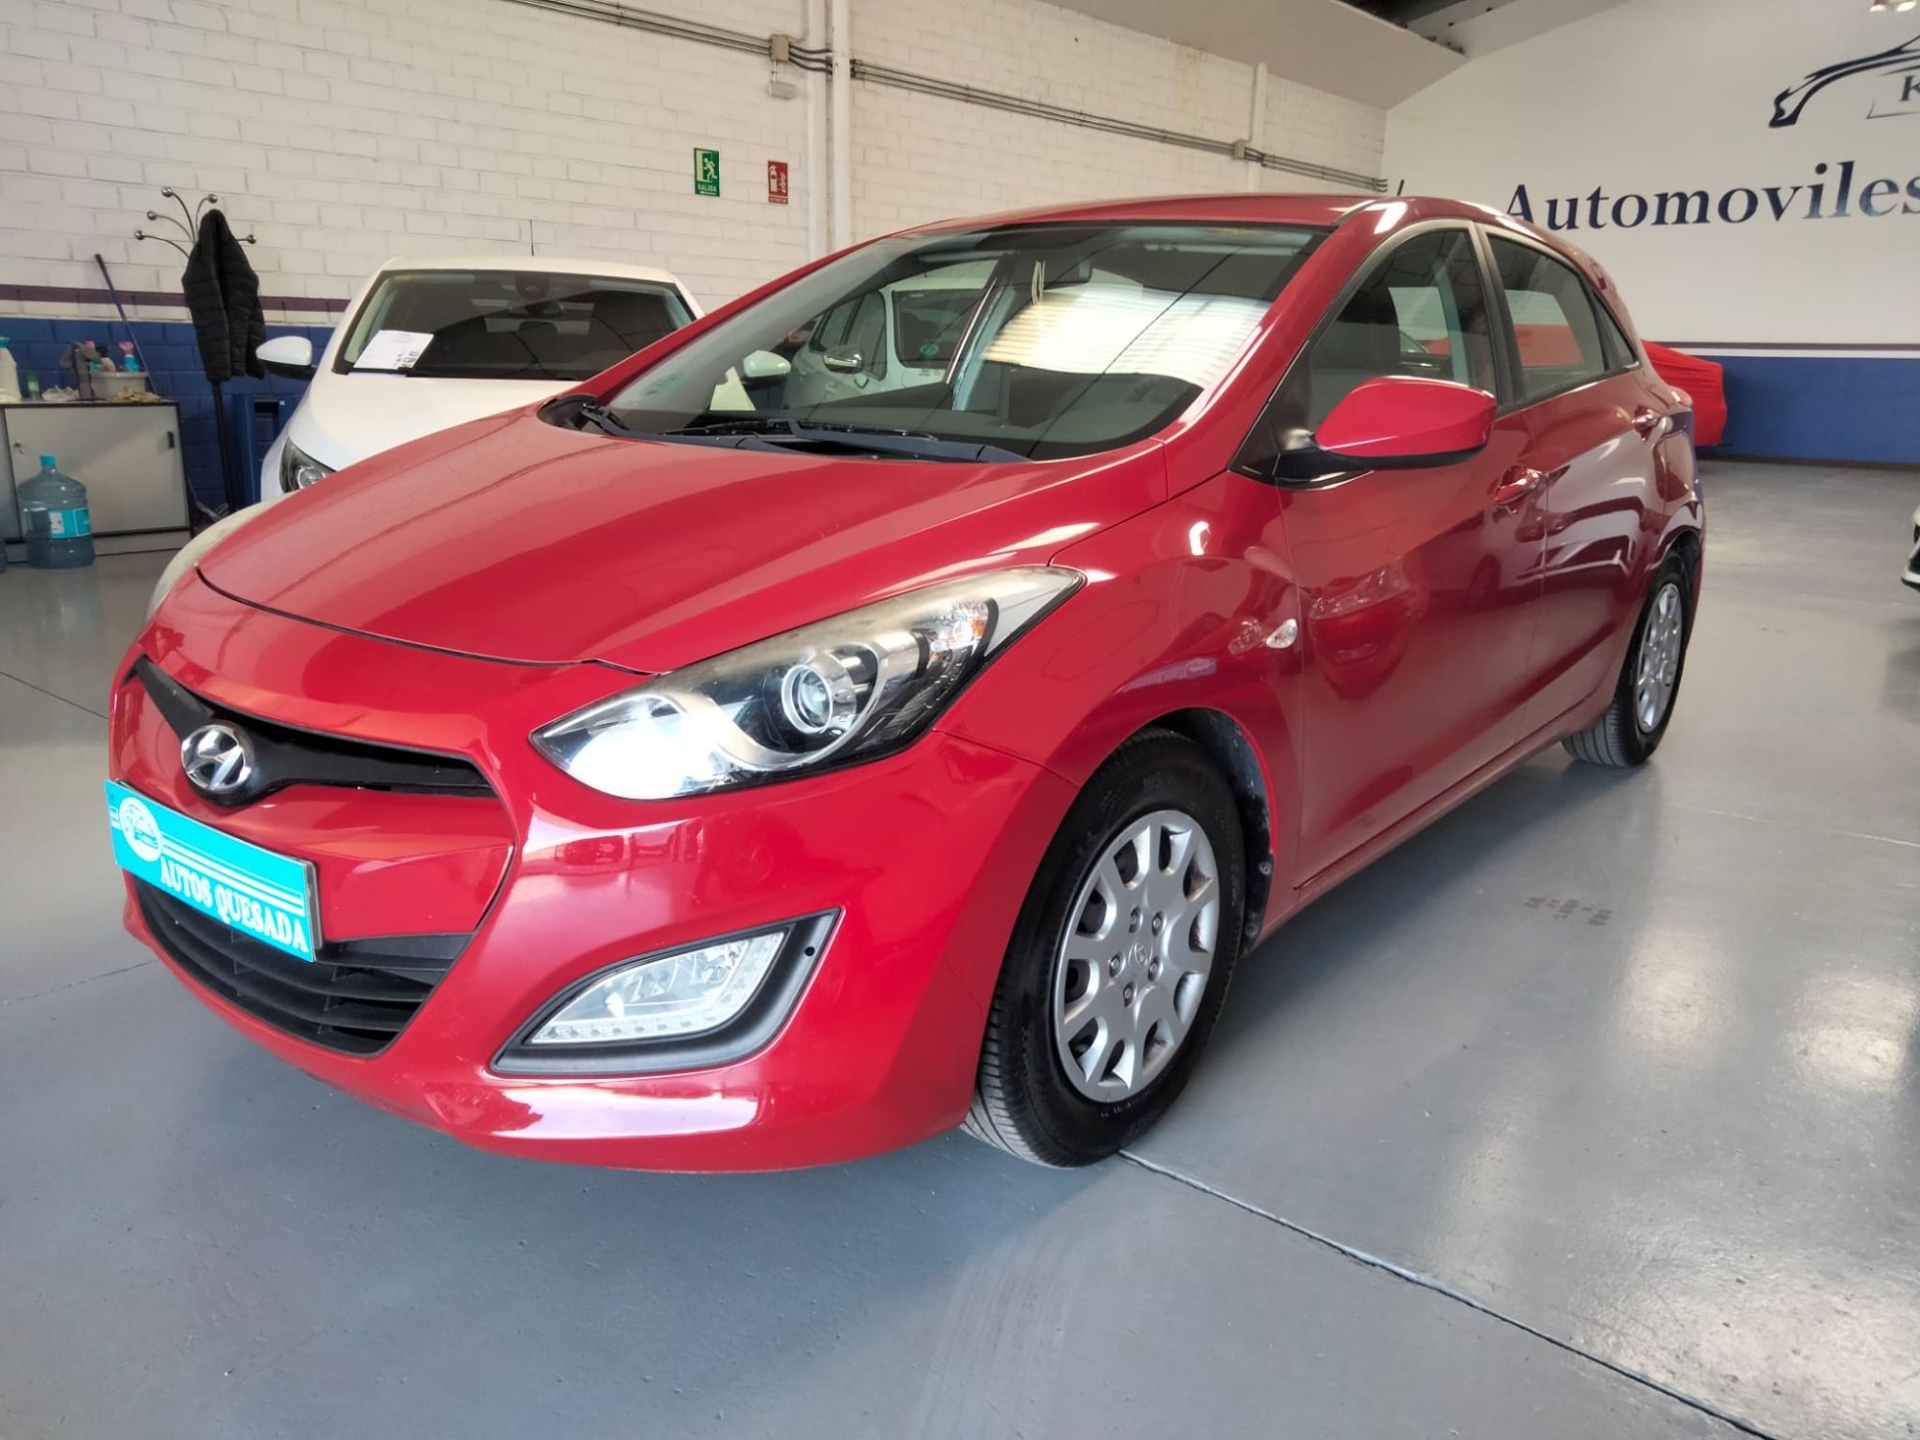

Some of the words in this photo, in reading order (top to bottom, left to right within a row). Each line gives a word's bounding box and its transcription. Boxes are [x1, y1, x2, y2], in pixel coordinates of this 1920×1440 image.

[1506, 160, 1920, 230] Automoviles
[160, 858, 212, 907] AUTOS
[215, 884, 308, 952] QUESADA
